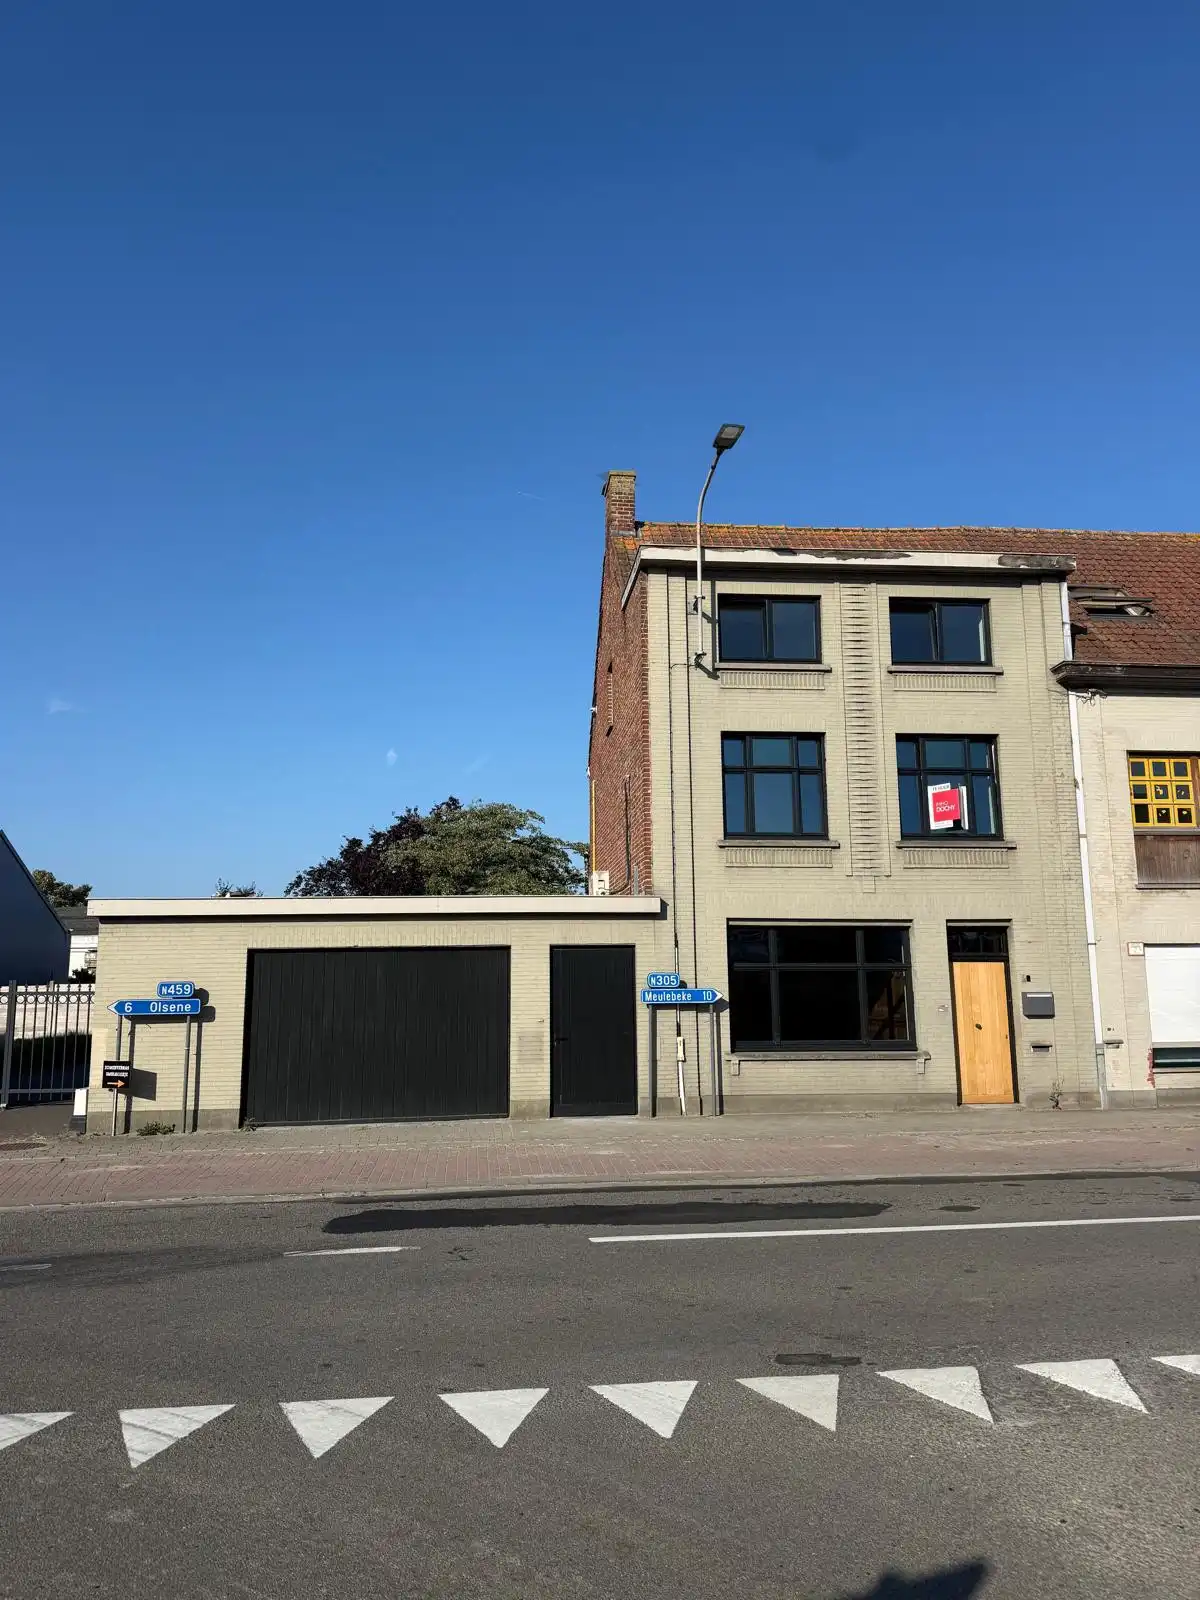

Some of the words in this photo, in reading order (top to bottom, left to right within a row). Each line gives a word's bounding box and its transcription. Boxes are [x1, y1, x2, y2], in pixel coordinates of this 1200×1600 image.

[650, 975, 677, 986] N305
[161, 984, 191, 995] N459
[644, 991, 692, 1002] Meulebeke
[702, 991, 712, 1001] 10
[124, 1002, 133, 1012] 6
[149, 1001, 192, 1012] Olsene
